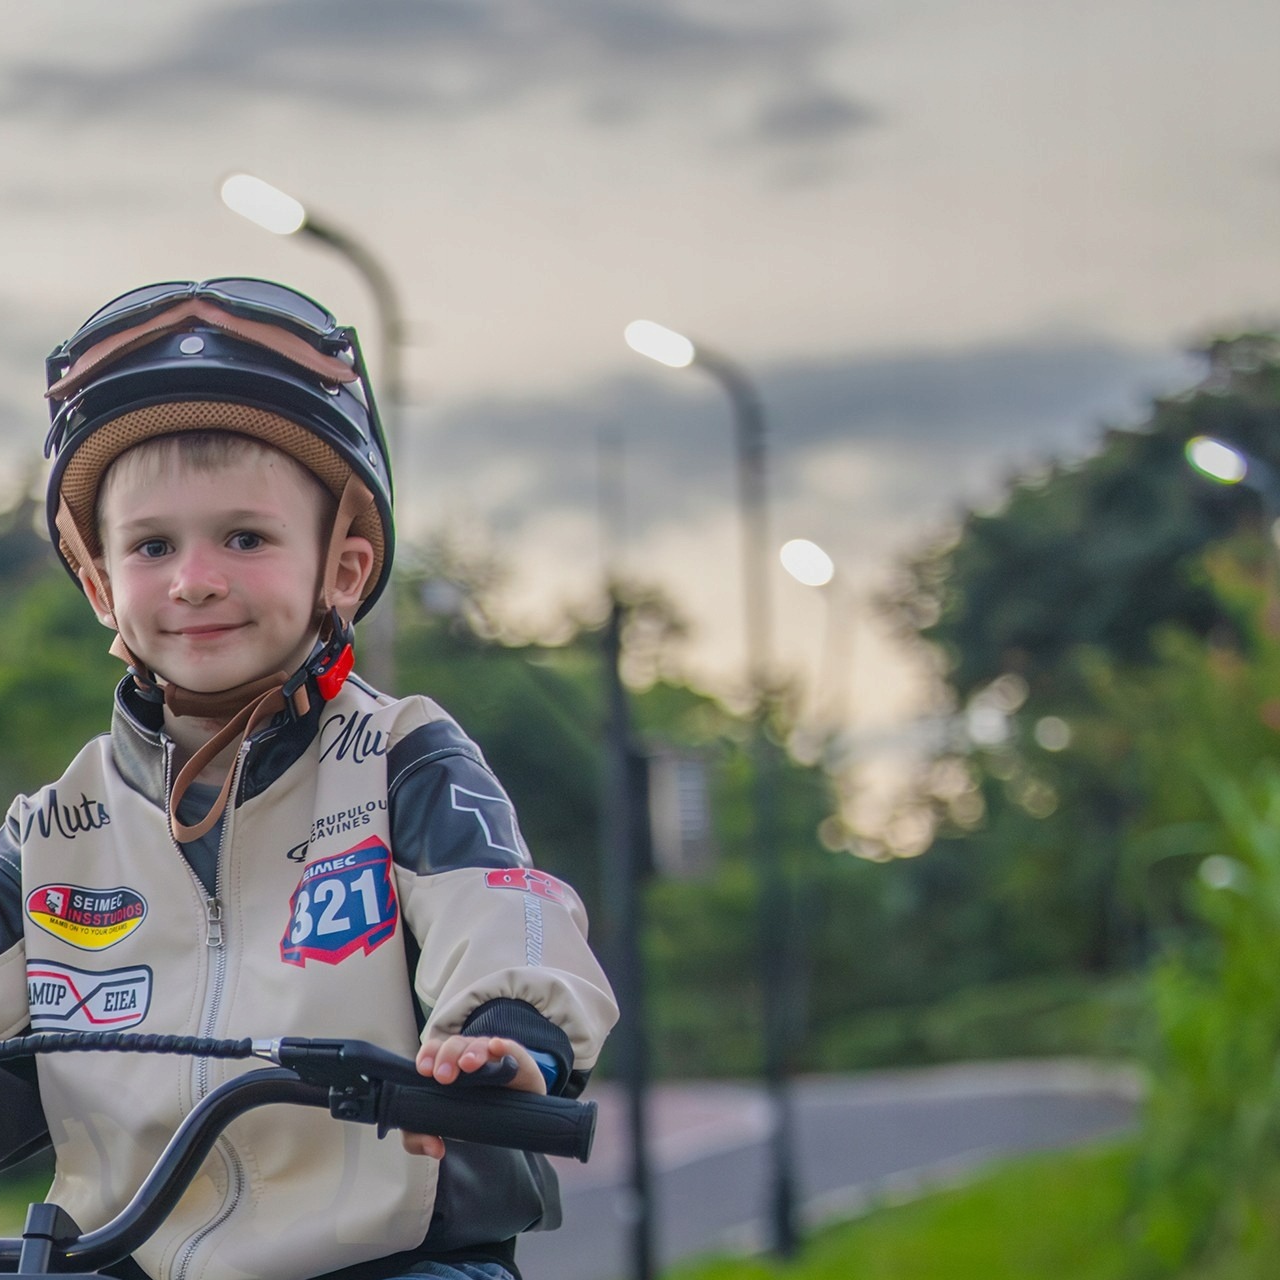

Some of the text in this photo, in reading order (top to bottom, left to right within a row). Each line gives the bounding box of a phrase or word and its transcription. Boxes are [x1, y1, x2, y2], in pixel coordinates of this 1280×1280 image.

[303, 854, 357, 881] EIMEC
[68, 902, 143, 925] INSSTUDIOS
[73, 894, 123, 911] SEIMEC
[291, 868, 382, 945] 321
[91, 928, 108, 936] YOUR
[103, 989, 137, 1012] EIEA
